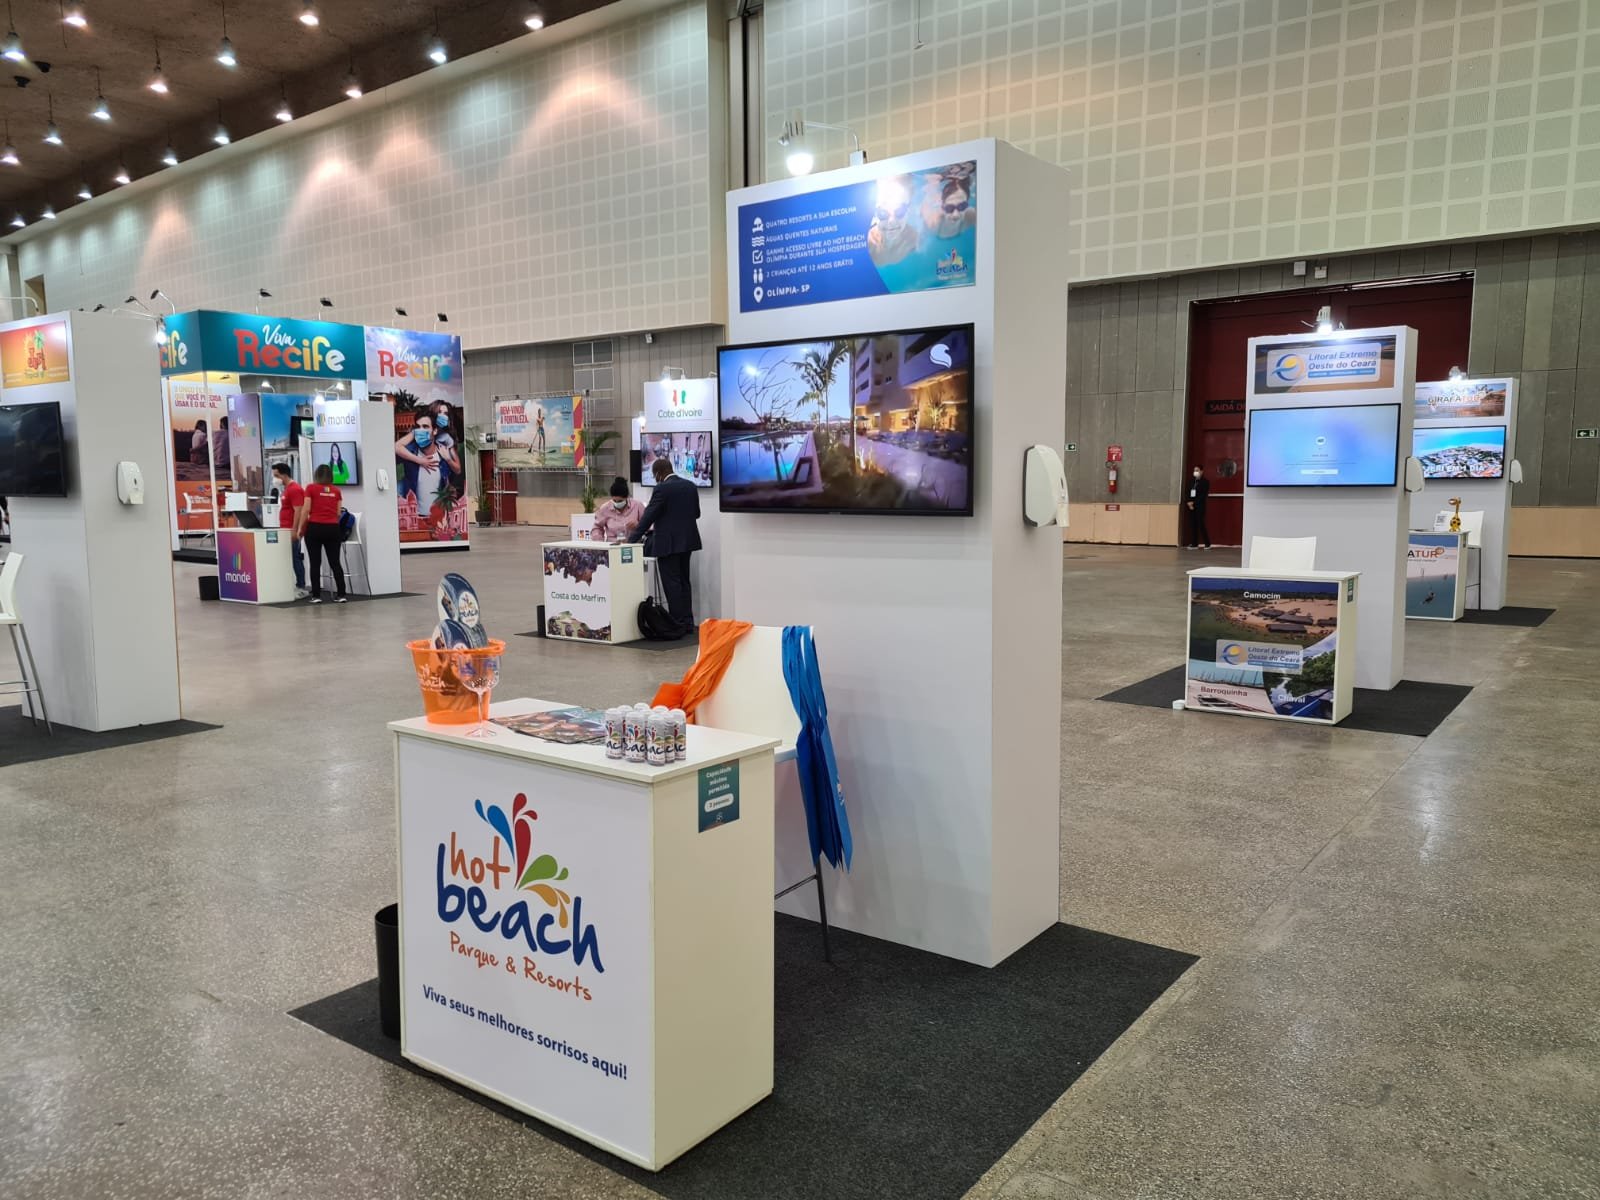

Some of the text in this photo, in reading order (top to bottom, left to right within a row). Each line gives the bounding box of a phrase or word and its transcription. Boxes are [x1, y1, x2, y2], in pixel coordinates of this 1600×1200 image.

[765, 218, 788, 229] QUATRO
[788, 213, 812, 224] RESORTS
[831, 206, 857, 217] ESCOLHA
[784, 229, 810, 240] QUENTES
[810, 225, 838, 235] NATURAIS
[765, 246, 784, 256] GANHE
[785, 244, 807, 253] ACESSO
[806, 241, 822, 250] LIVRE
[832, 237, 844, 245] HOT
[845, 233, 865, 243] BEACH
[788, 250, 814, 260] DURANTE
[815, 248, 827, 256] SUA
[827, 241, 867, 253] HOSPEDAGEM
[770, 266, 797, 278] CRIANÇAS
[816, 262, 833, 270] ANOS
[801, 284, 811, 293] SP
[262, 324, 296, 347] Viva
[233, 328, 346, 373] Recife
[1308, 350, 1378, 361] Litoral Extremo
[1308, 361, 1334, 370] Oeste
[1336, 360, 1348, 368] do
[328, 414, 356, 425] monde
[1408, 550, 1438, 558] ATUR
[225, 570, 251, 584] monde
[551, 591, 607, 603] Costa do Marfim
[1243, 591, 1281, 600] Camocim
[1247, 646, 1270, 654] Litoral
[1200, 685, 1248, 698] Barroquinha
[1277, 693, 1306, 704] Chaval
[450, 831, 511, 890] hot
[436, 842, 605, 974] beach
[449, 931, 593, 1002] Parque & Resorts
[423, 984, 628, 1081] Viva seus melhores sorrisos aqui!
